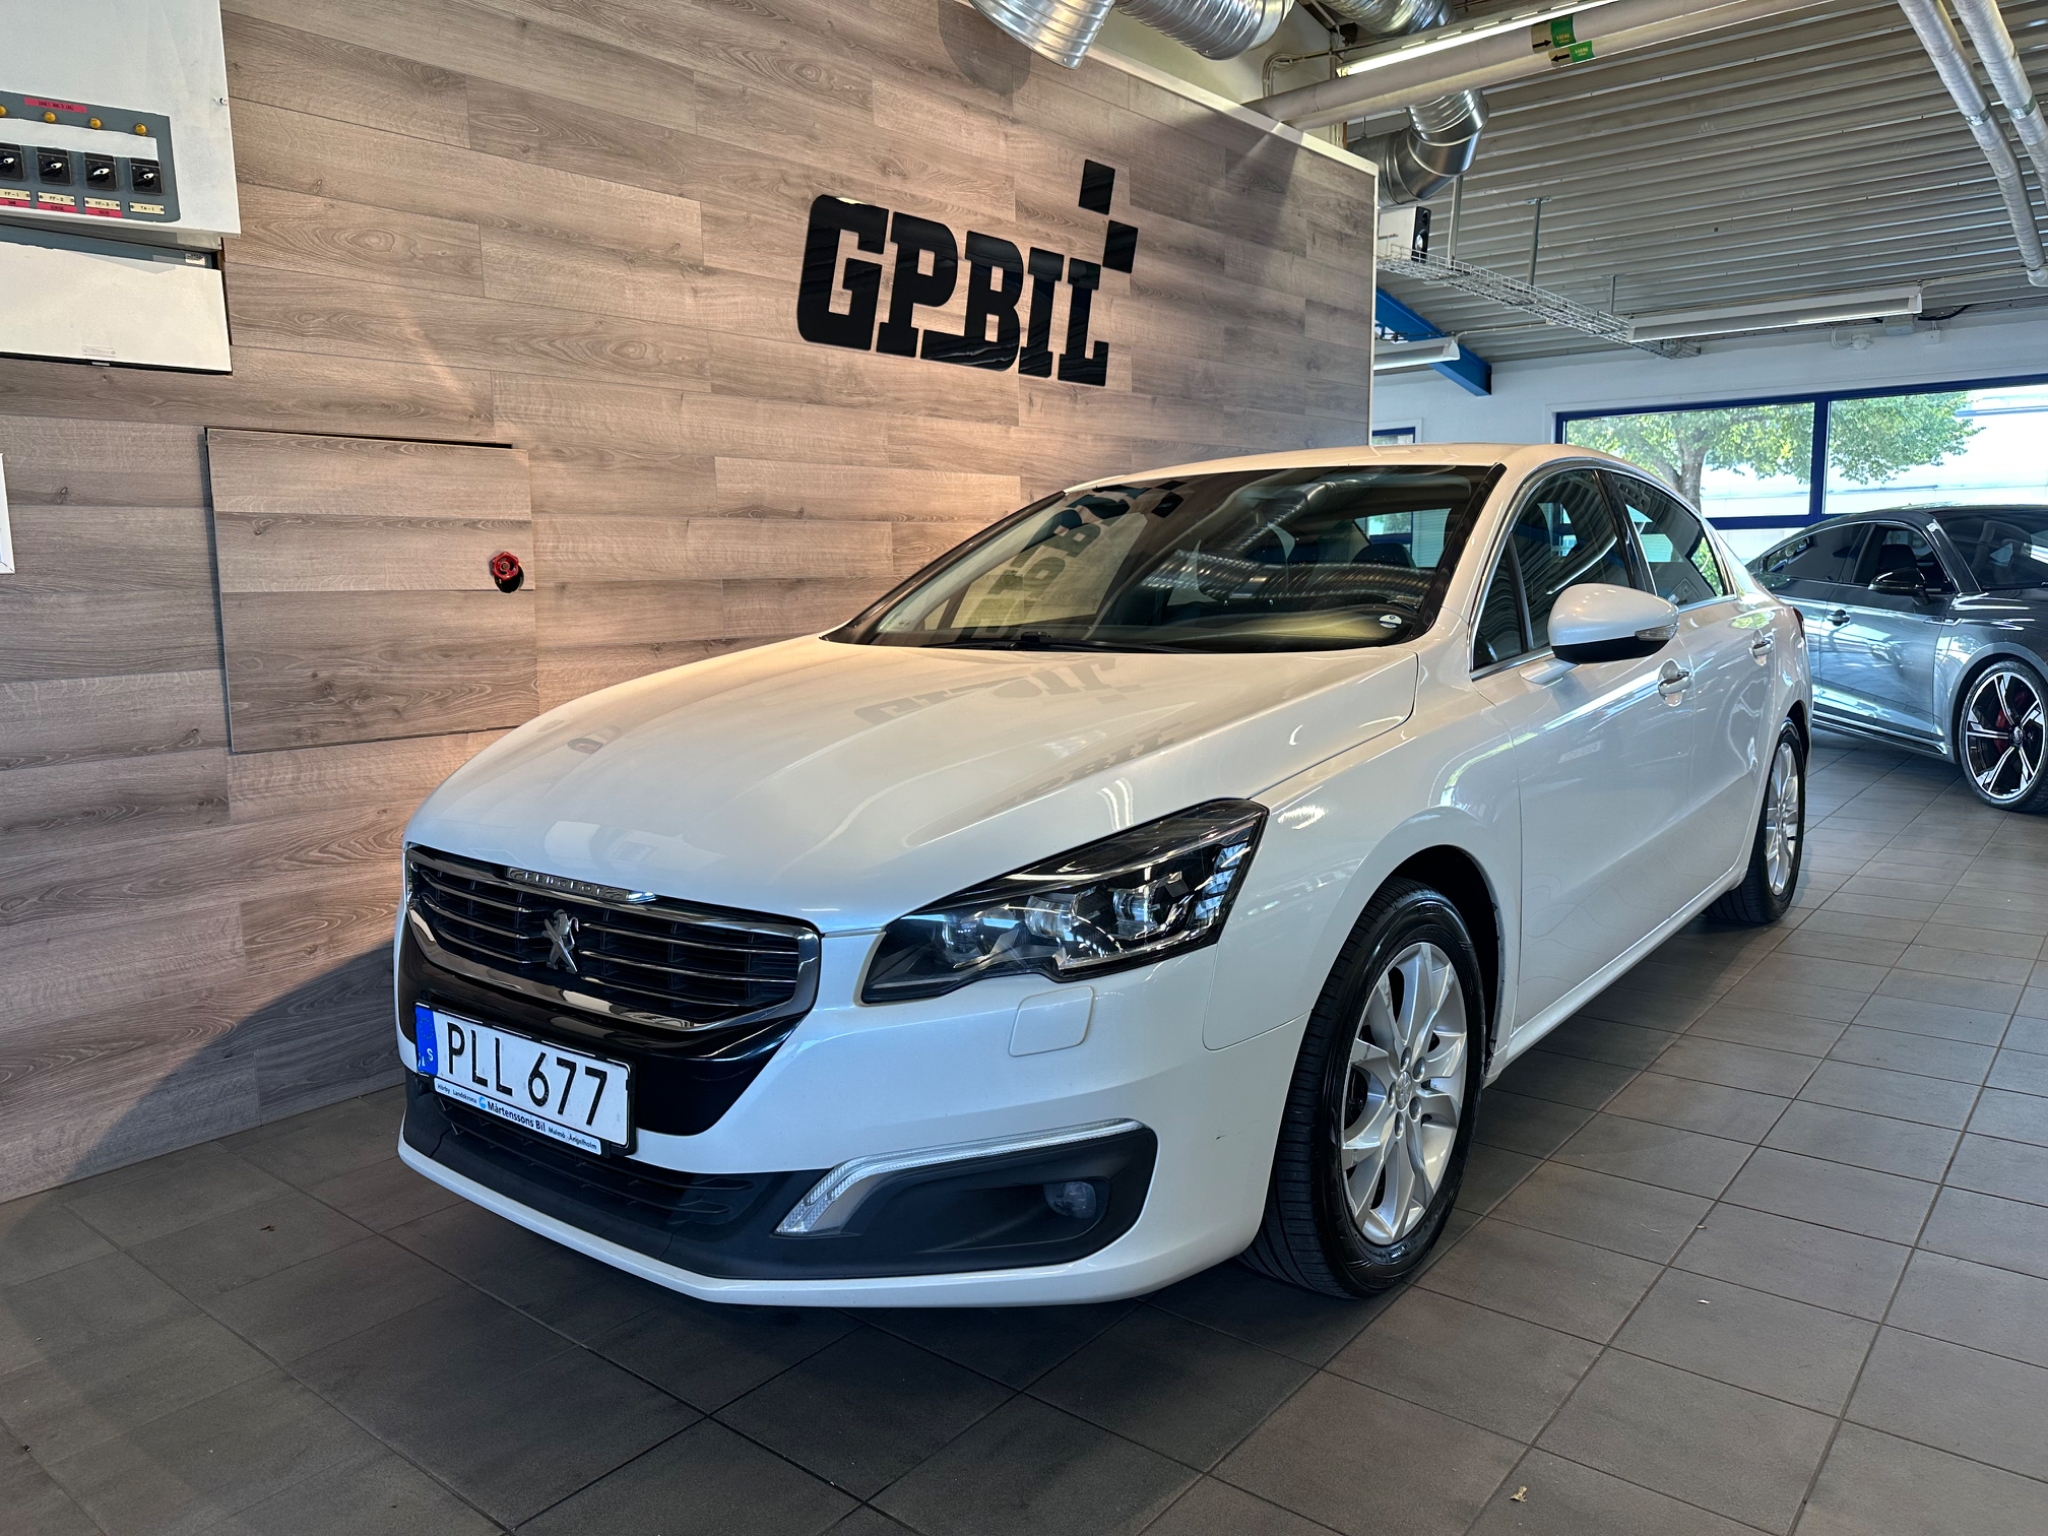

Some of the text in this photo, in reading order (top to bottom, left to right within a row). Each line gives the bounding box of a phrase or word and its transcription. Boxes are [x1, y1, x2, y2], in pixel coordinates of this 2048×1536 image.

[797, 194, 1109, 386] GPBIL
[426, 1047, 434, 1062] S
[447, 1021, 608, 1126] PLL 677
[452, 1089, 478, 1104] Landskrona
[487, 1100, 535, 1128] Mårtenssons
[535, 1119, 546, 1132] Bil
